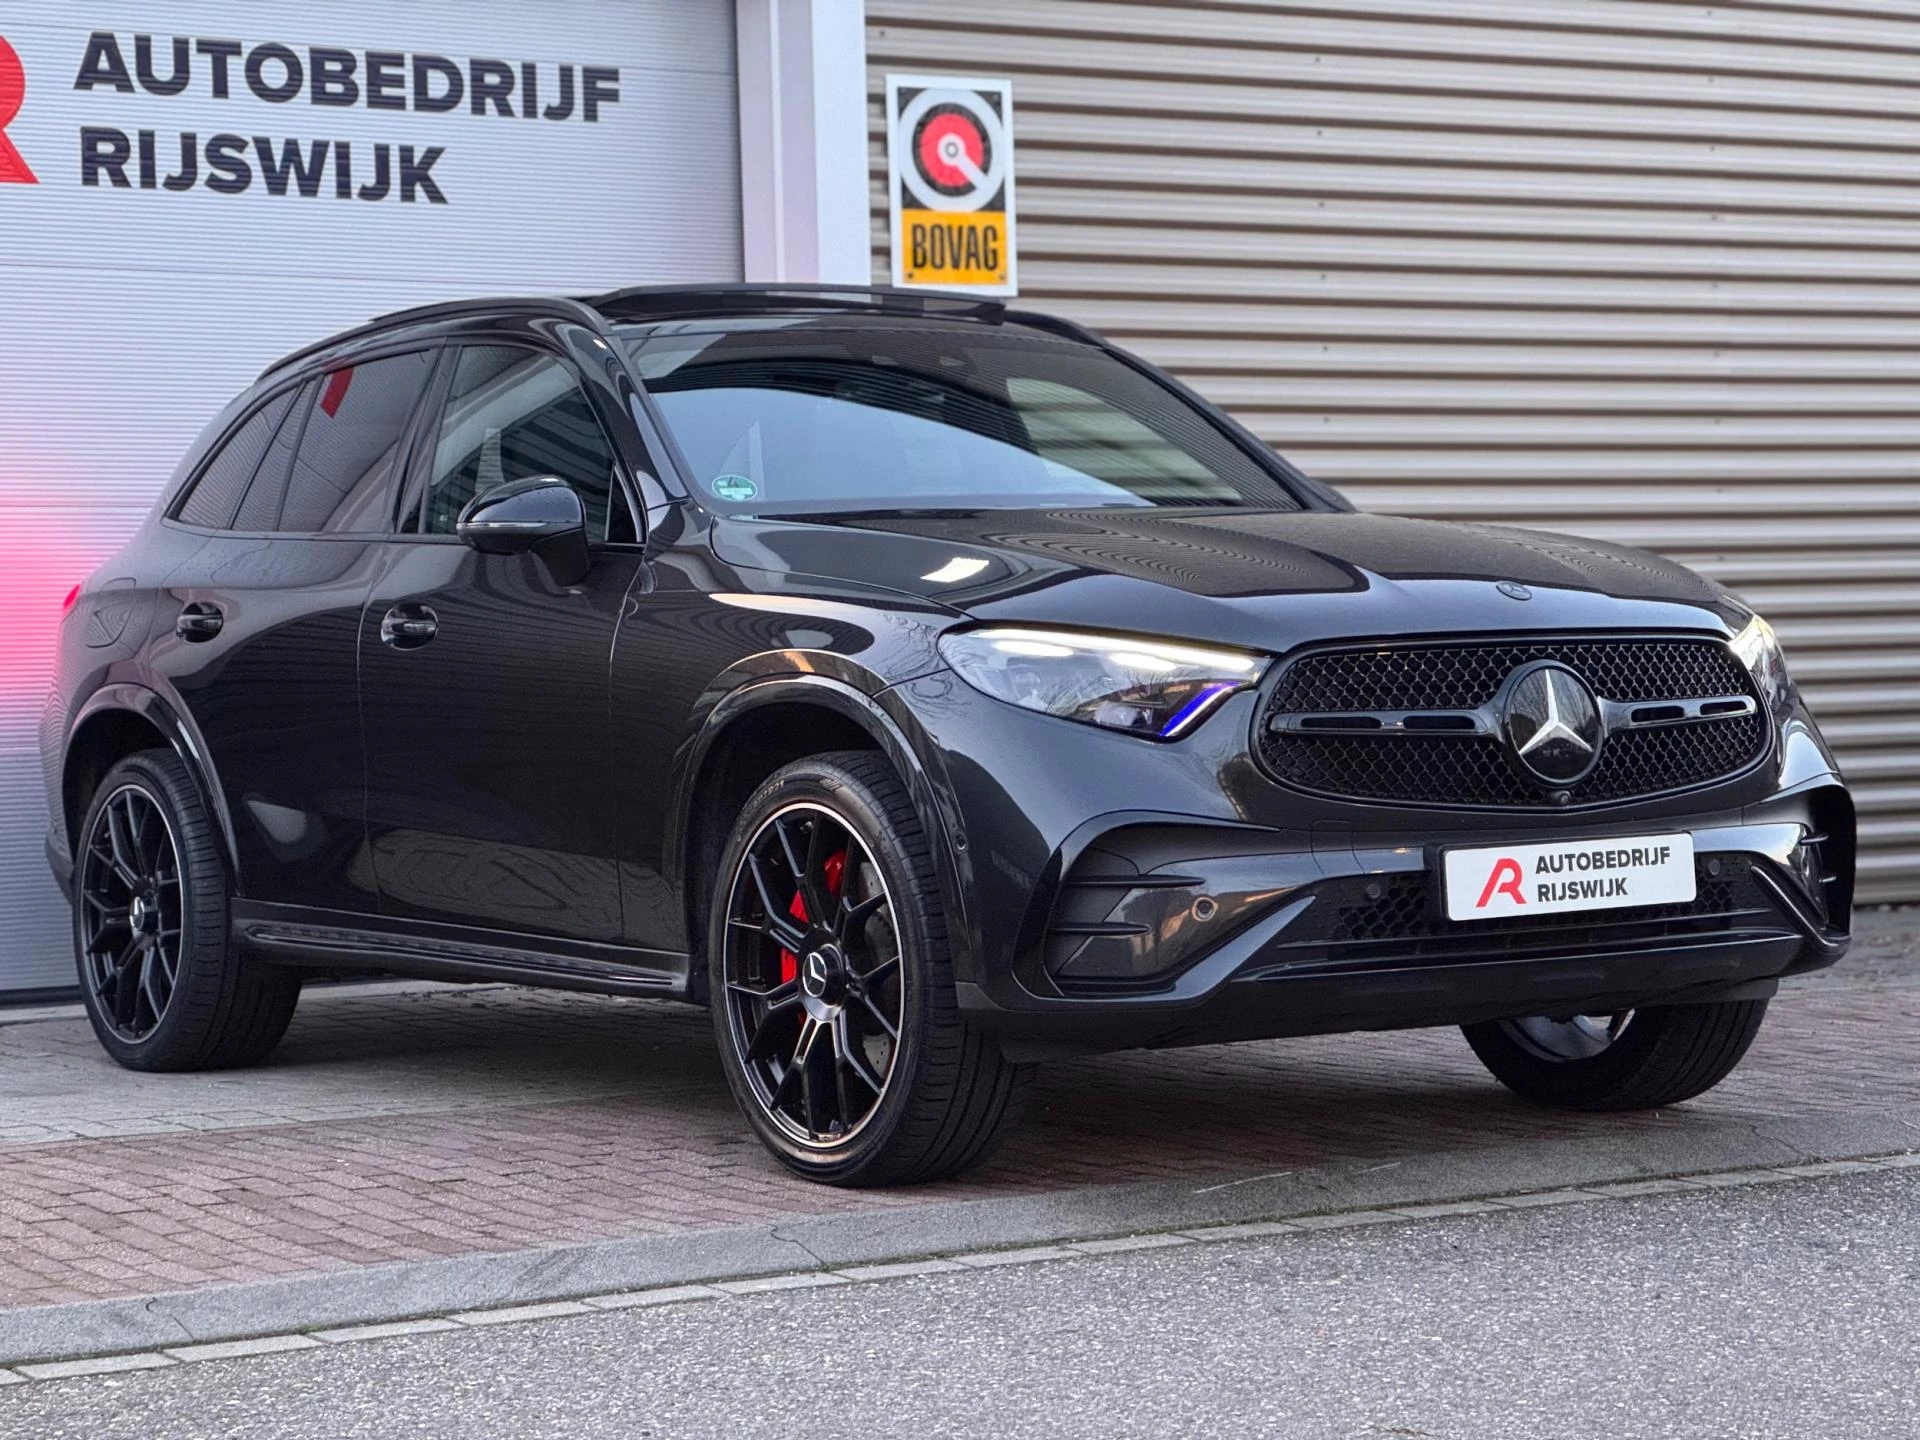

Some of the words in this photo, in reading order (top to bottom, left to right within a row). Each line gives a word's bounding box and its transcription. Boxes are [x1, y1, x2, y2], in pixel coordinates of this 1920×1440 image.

[74, 32, 620, 122] AUTOBEDRIJF
[81, 126, 448, 203] RIJSWIJK
[912, 224, 998, 271] BOVAG
[1535, 847, 1670, 875] AUTOBEDRIJF
[1537, 877, 1628, 902] RIJSWIJK
